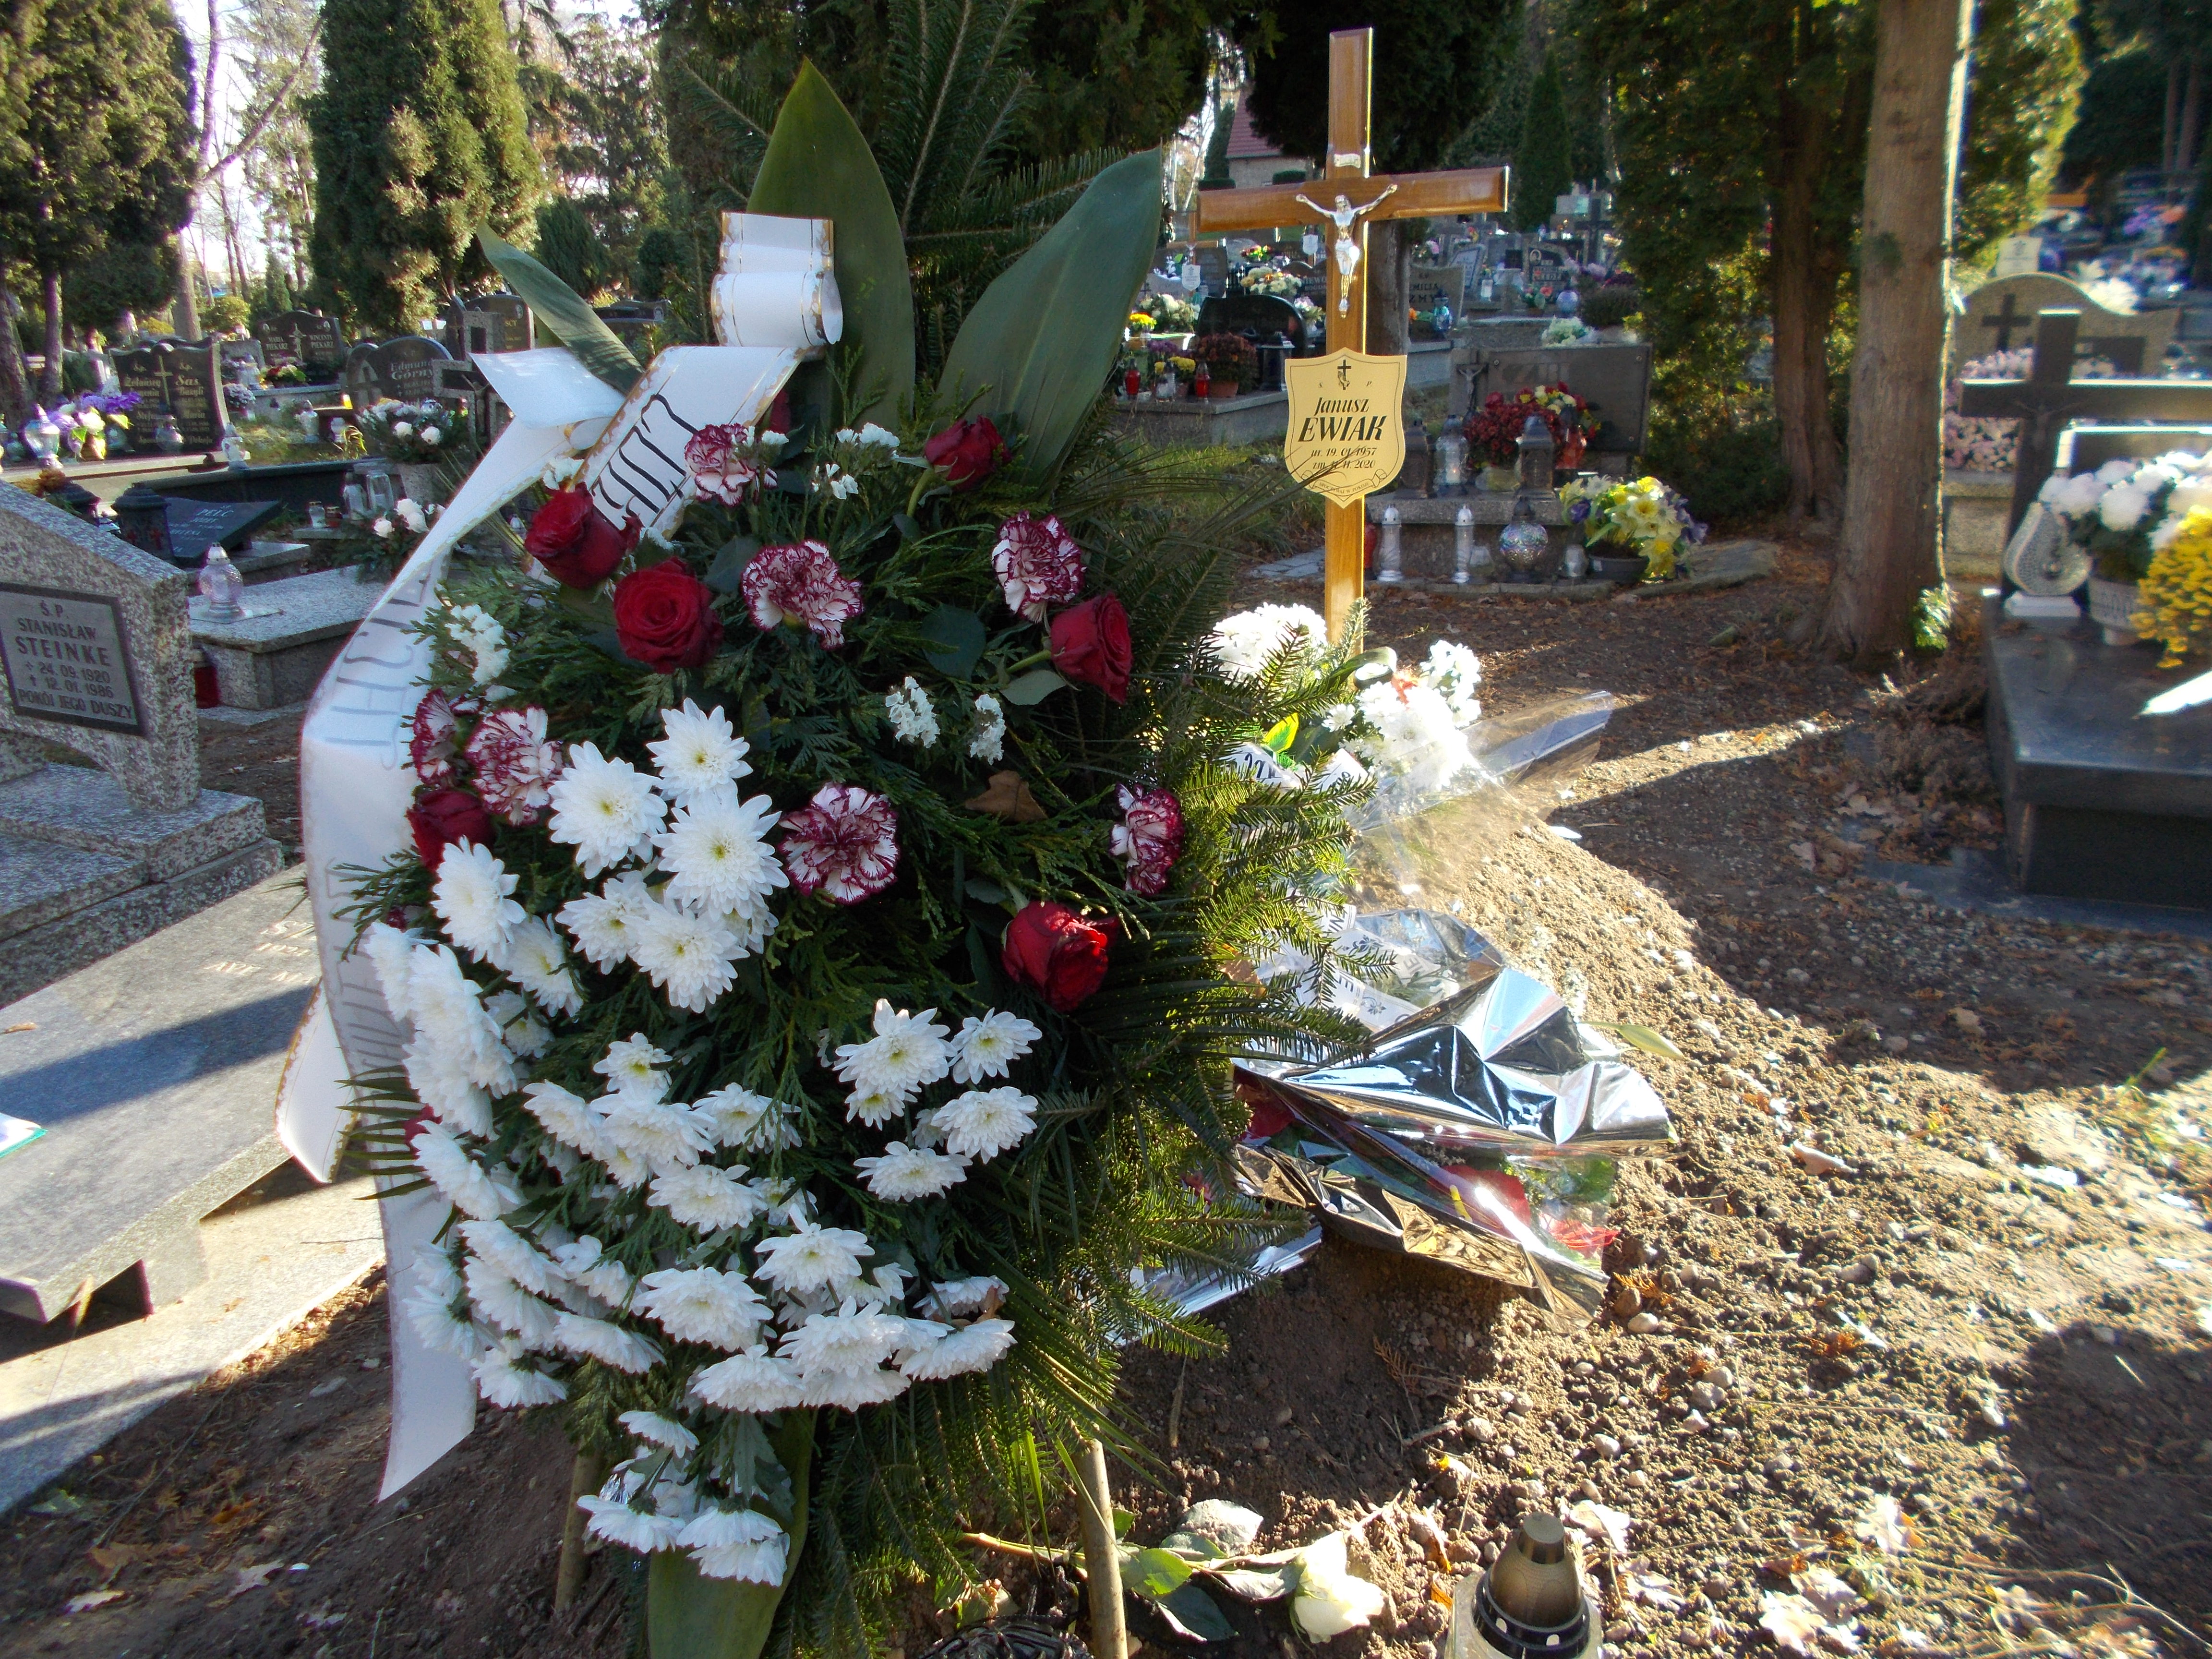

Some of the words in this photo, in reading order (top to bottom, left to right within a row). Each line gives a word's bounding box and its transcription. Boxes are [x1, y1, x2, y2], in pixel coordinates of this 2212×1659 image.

[1313, 397, 1369, 416] Janusz
[1298, 415, 1387, 442] EWIAK
[15, 636, 111, 667] STEINKE
